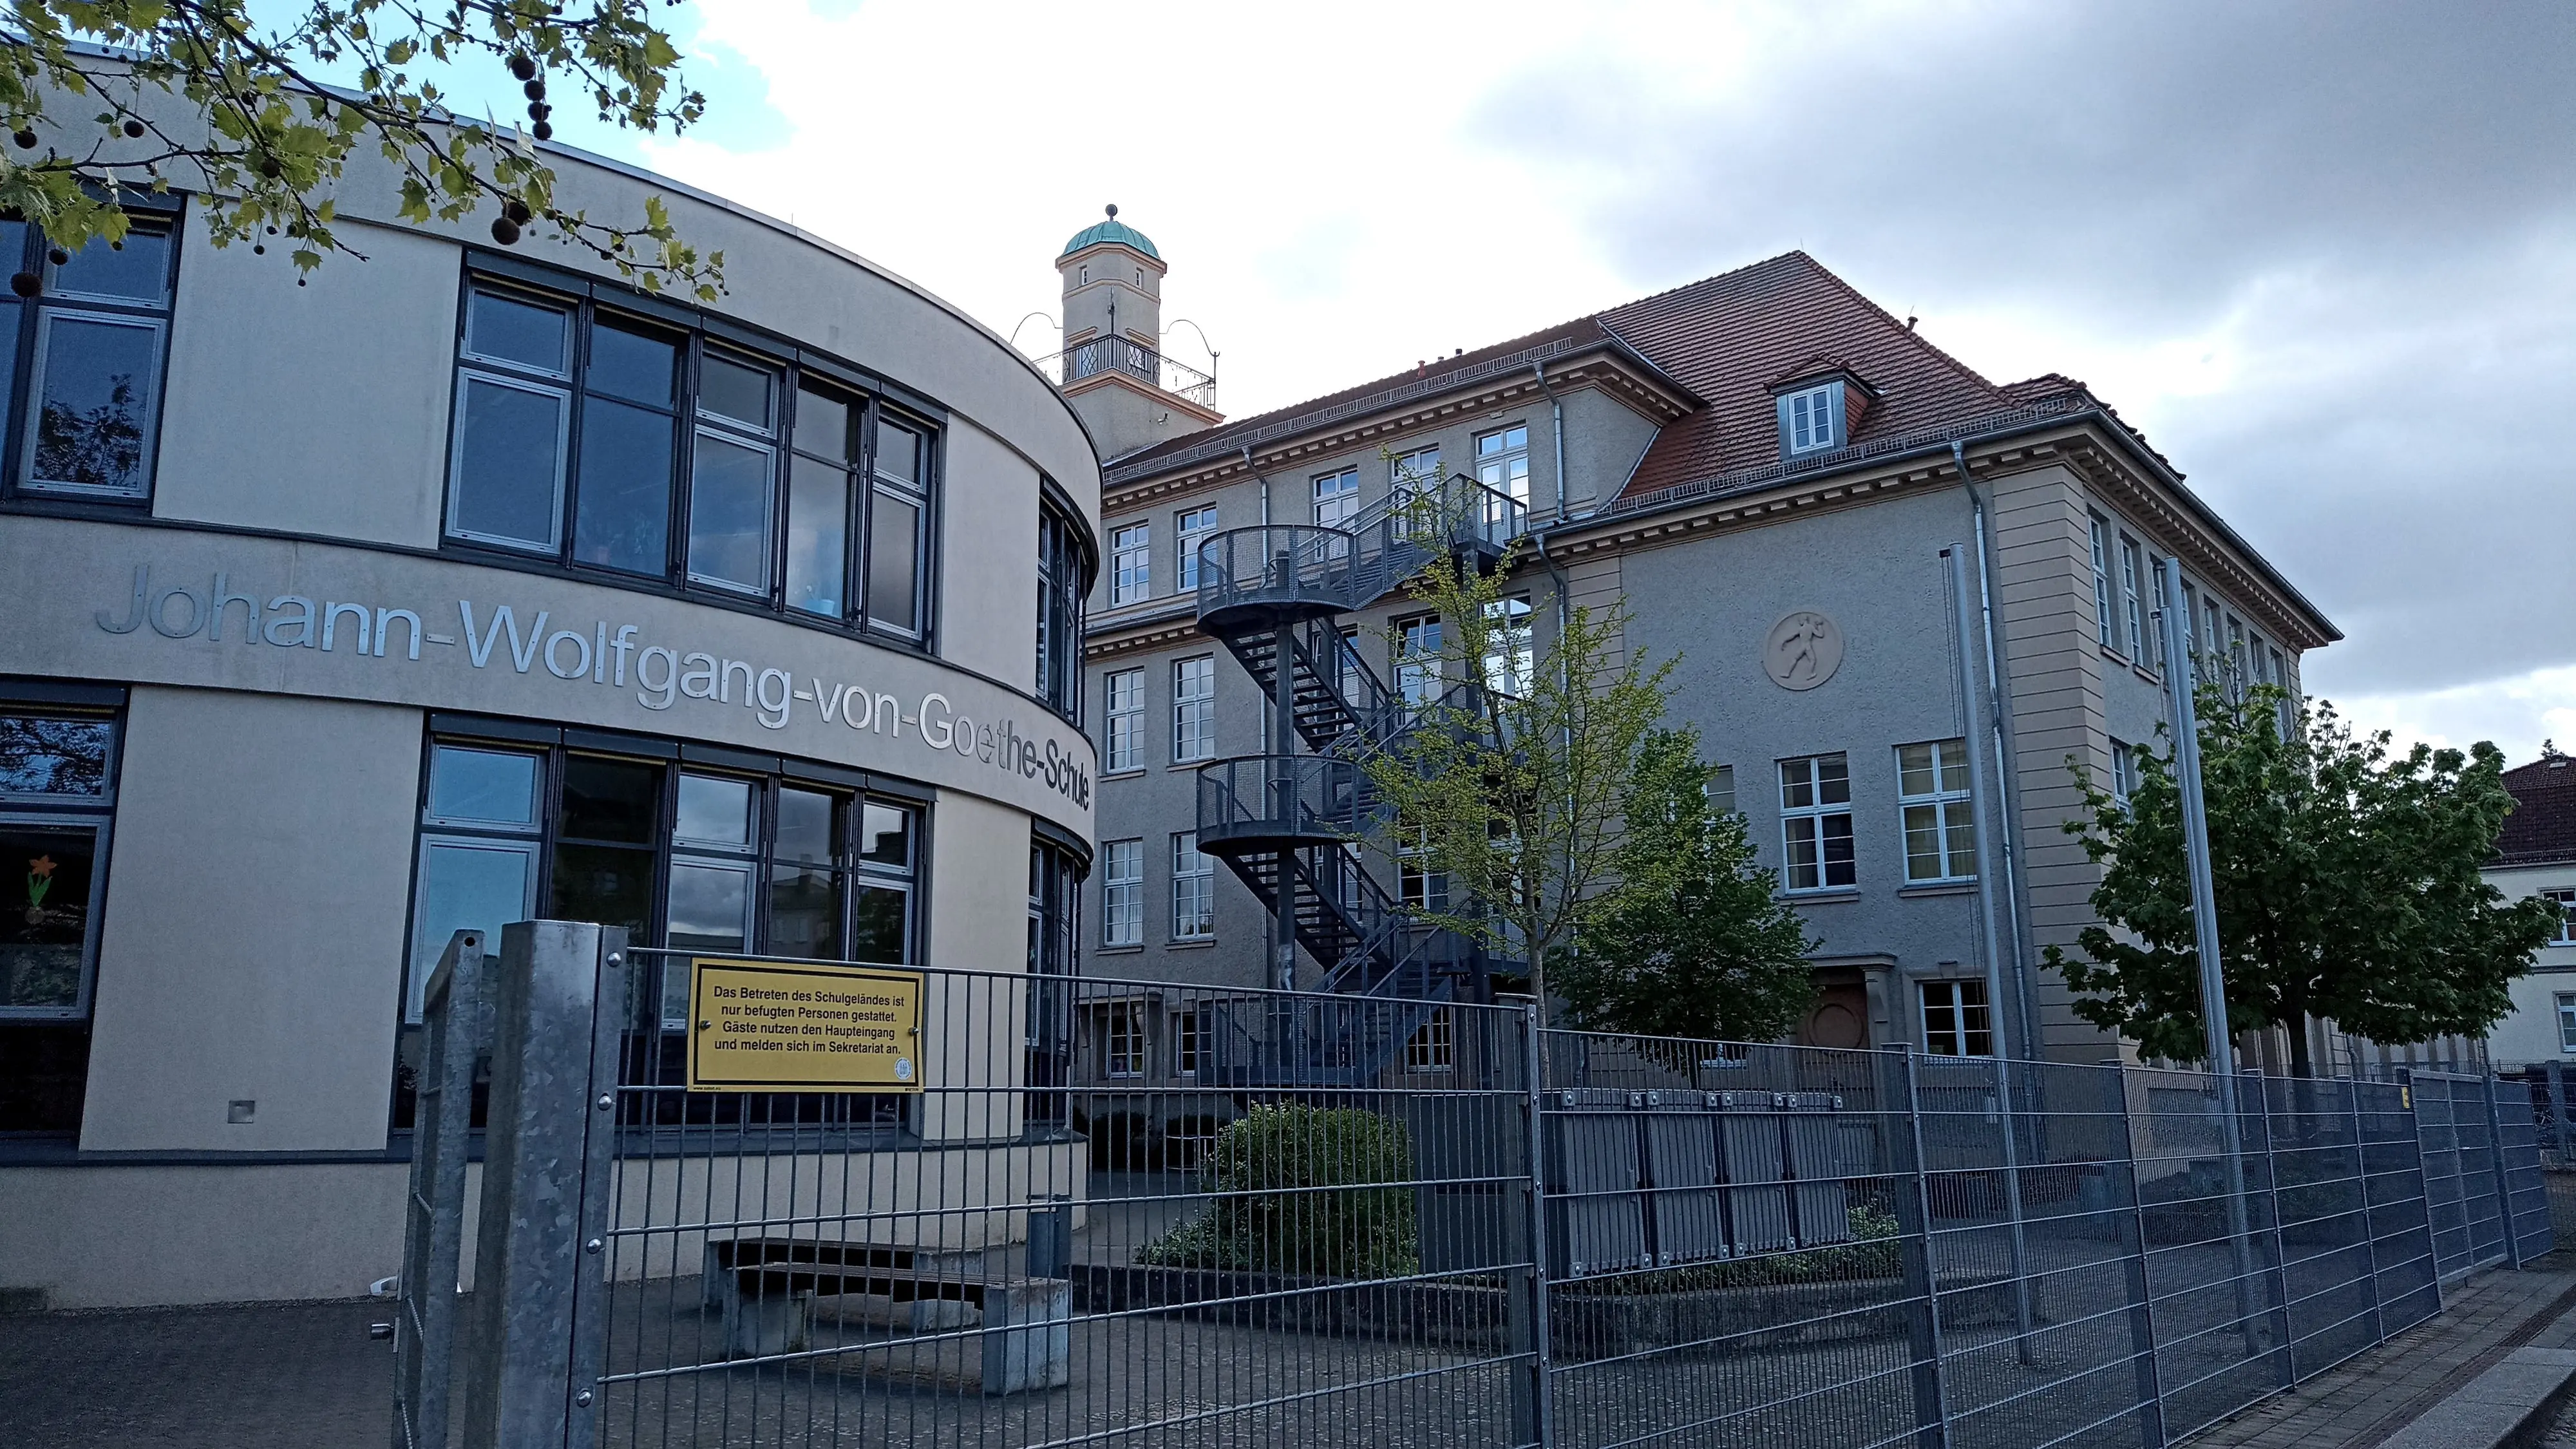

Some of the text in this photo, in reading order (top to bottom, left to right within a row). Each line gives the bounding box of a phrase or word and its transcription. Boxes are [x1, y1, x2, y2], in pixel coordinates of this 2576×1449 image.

[95, 564, 1090, 812] Johann-Wolfgang-von-Goethe-Schule
[714, 986, 905, 1007] Das Betreten des Schulgeländes ist
[721, 1005, 897, 1023] nur befugten Personen gestattet.
[723, 1021, 895, 1041] Gäste nutzen den Haupteingang
[715, 1039, 901, 1054] und melden sich im Sekretariat an.
